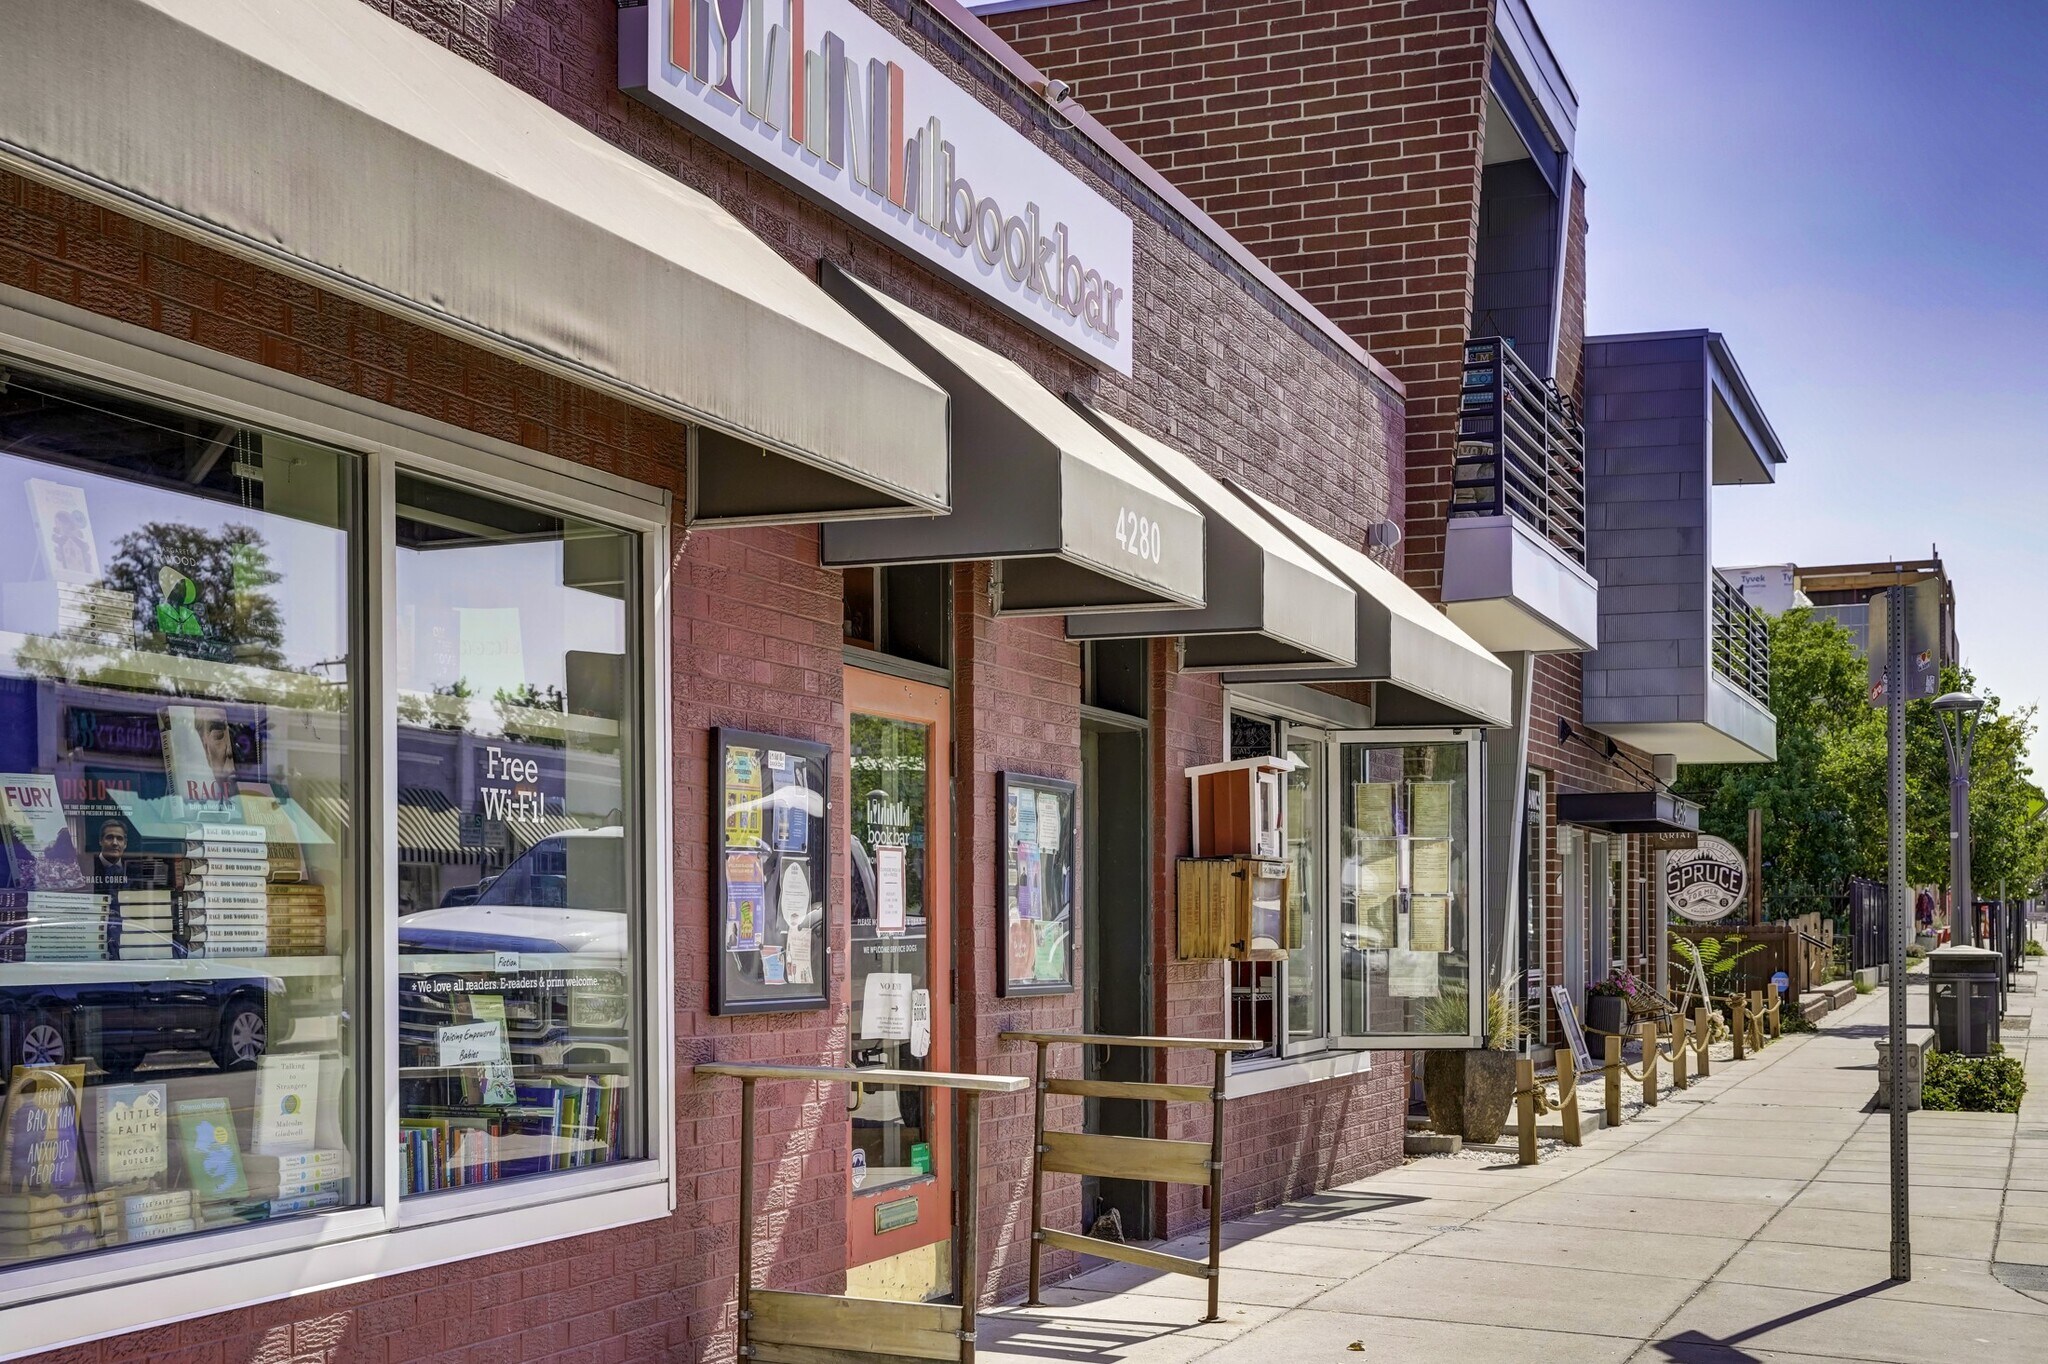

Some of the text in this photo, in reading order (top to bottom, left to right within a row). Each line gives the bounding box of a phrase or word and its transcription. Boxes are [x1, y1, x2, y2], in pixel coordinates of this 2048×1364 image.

[940, 139, 1123, 342] bookbar
[1115, 506, 1161, 565] 4280
[1741, 575, 1765, 584] Tyvek
[486, 746, 539, 784] Free
[4, 786, 53, 808] FURY
[480, 787, 545, 824] Wi-Fi!
[867, 825, 910, 845] bookbar
[105, 876, 128, 884] COHEN
[1667, 864, 1740, 894] SPRUCE
[1689, 887, 1719, 901] FOR MEN
[857, 918, 872, 926] PLEASE
[863, 946, 870, 954] WE
[890, 945, 906, 953] SERVICE
[906, 944, 917, 952] DOGS
[497, 956, 518, 967] Fiction
[433, 980, 451, 993] love
[453, 978, 464, 991] all
[465, 977, 499, 991] readers.
[500, 974, 538, 989] E-readers
[539, 976, 546, 988] &
[546, 975, 565, 989] print
[565, 974, 600, 988] welcome.
[441, 1024, 498, 1044] Raising Empowered
[459, 1049, 480, 1061] Babies
[281, 1063, 305, 1071] Talking
[276, 1083, 307, 1091] Strangers
[39, 1087, 70, 1106] FREDRIK
[26, 1105, 76, 1132] BACKMAN
[115, 1108, 160, 1121] LITTLE
[118, 1123, 157, 1135] FAITH
[276, 1120, 303, 1128] Malcolm
[275, 1129, 303, 1137] Gladwell
[27, 1139, 70, 1164] ANXIOUS
[117, 1146, 160, 1157] NICKOLAS
[122, 1157, 155, 1166] BUTLER
[29, 1162, 65, 1186] PEOPLE
[131, 1202, 153, 1210] LITTLE
